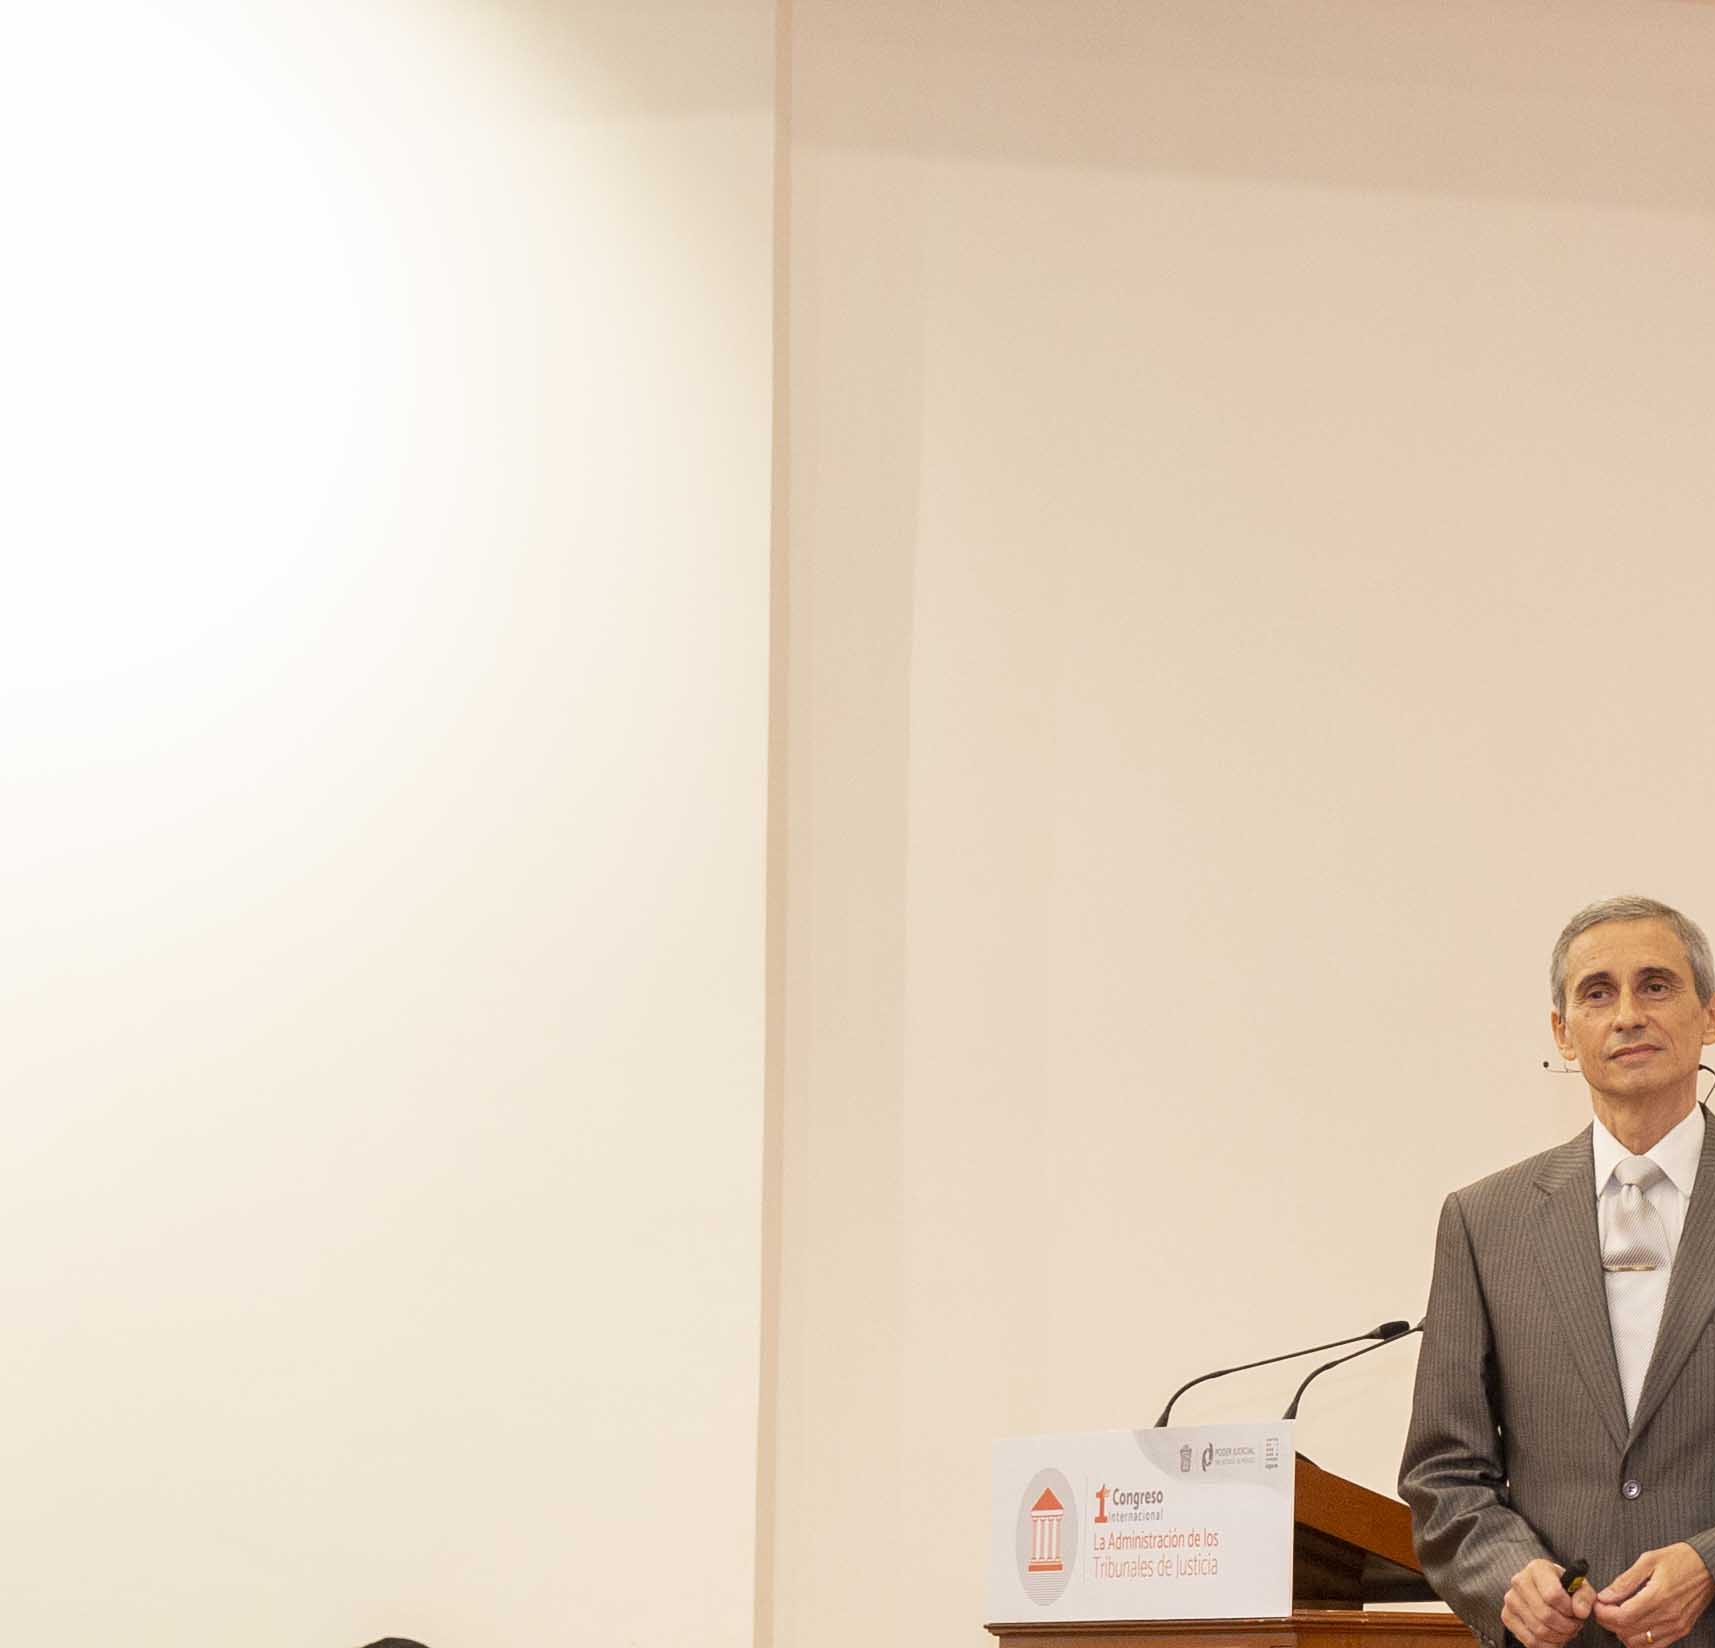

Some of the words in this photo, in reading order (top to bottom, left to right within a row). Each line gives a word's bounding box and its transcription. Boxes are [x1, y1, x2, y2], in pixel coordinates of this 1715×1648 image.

[1112, 1488, 1164, 1510] Congreso
[1109, 1507, 1164, 1522] Internacional
[1094, 1532, 1105, 1550] La
[1108, 1528, 1184, 1550] Administración
[1187, 1528, 1201, 1547] de
[1203, 1527, 1219, 1547] los
[1092, 1553, 1154, 1578] Tribunales
[1157, 1552, 1173, 1576] de
[1175, 1552, 1218, 1578] Justicia
